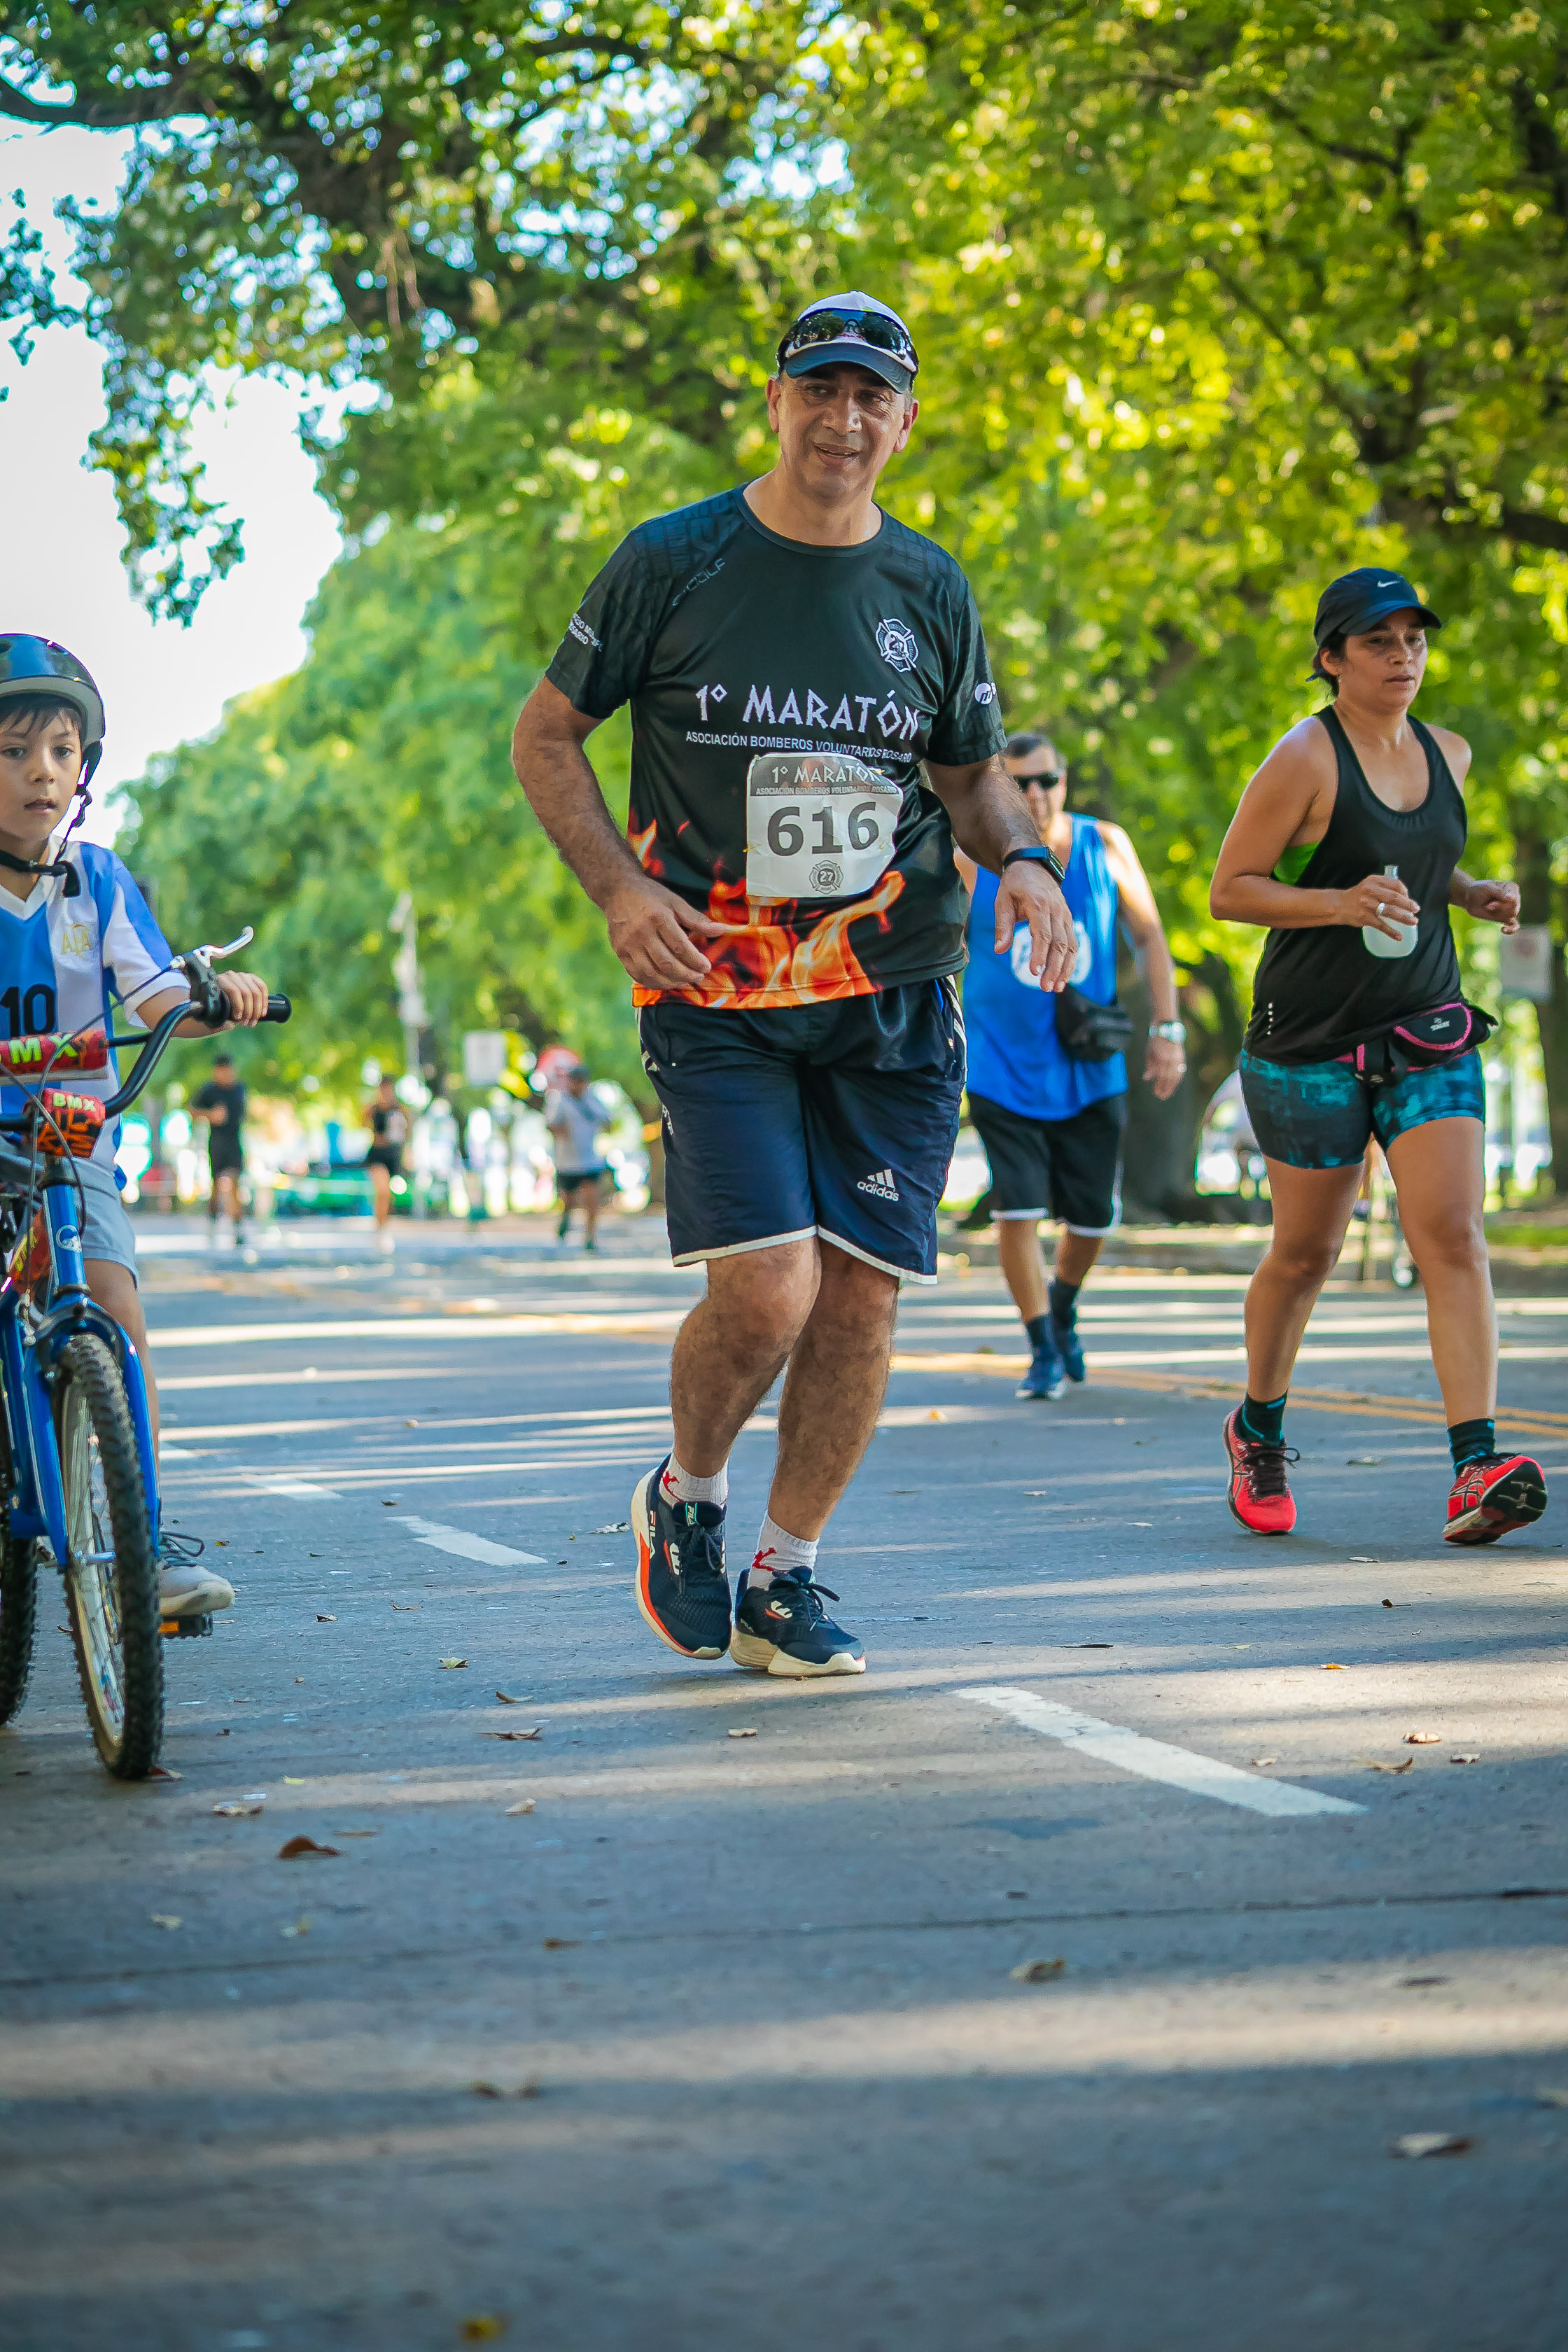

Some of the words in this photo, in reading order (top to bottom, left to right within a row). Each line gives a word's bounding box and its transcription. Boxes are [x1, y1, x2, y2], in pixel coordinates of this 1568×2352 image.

[742, 684, 921, 741] MARATÓN
[685, 732, 748, 747] ASOCIACIÓN
[750, 736, 813, 751] BOMBEROS
[767, 802, 879, 857] 616
[820, 870, 834, 883] 27
[0, 983, 55, 1039] 10
[857, 1181, 899, 1202] adidas
